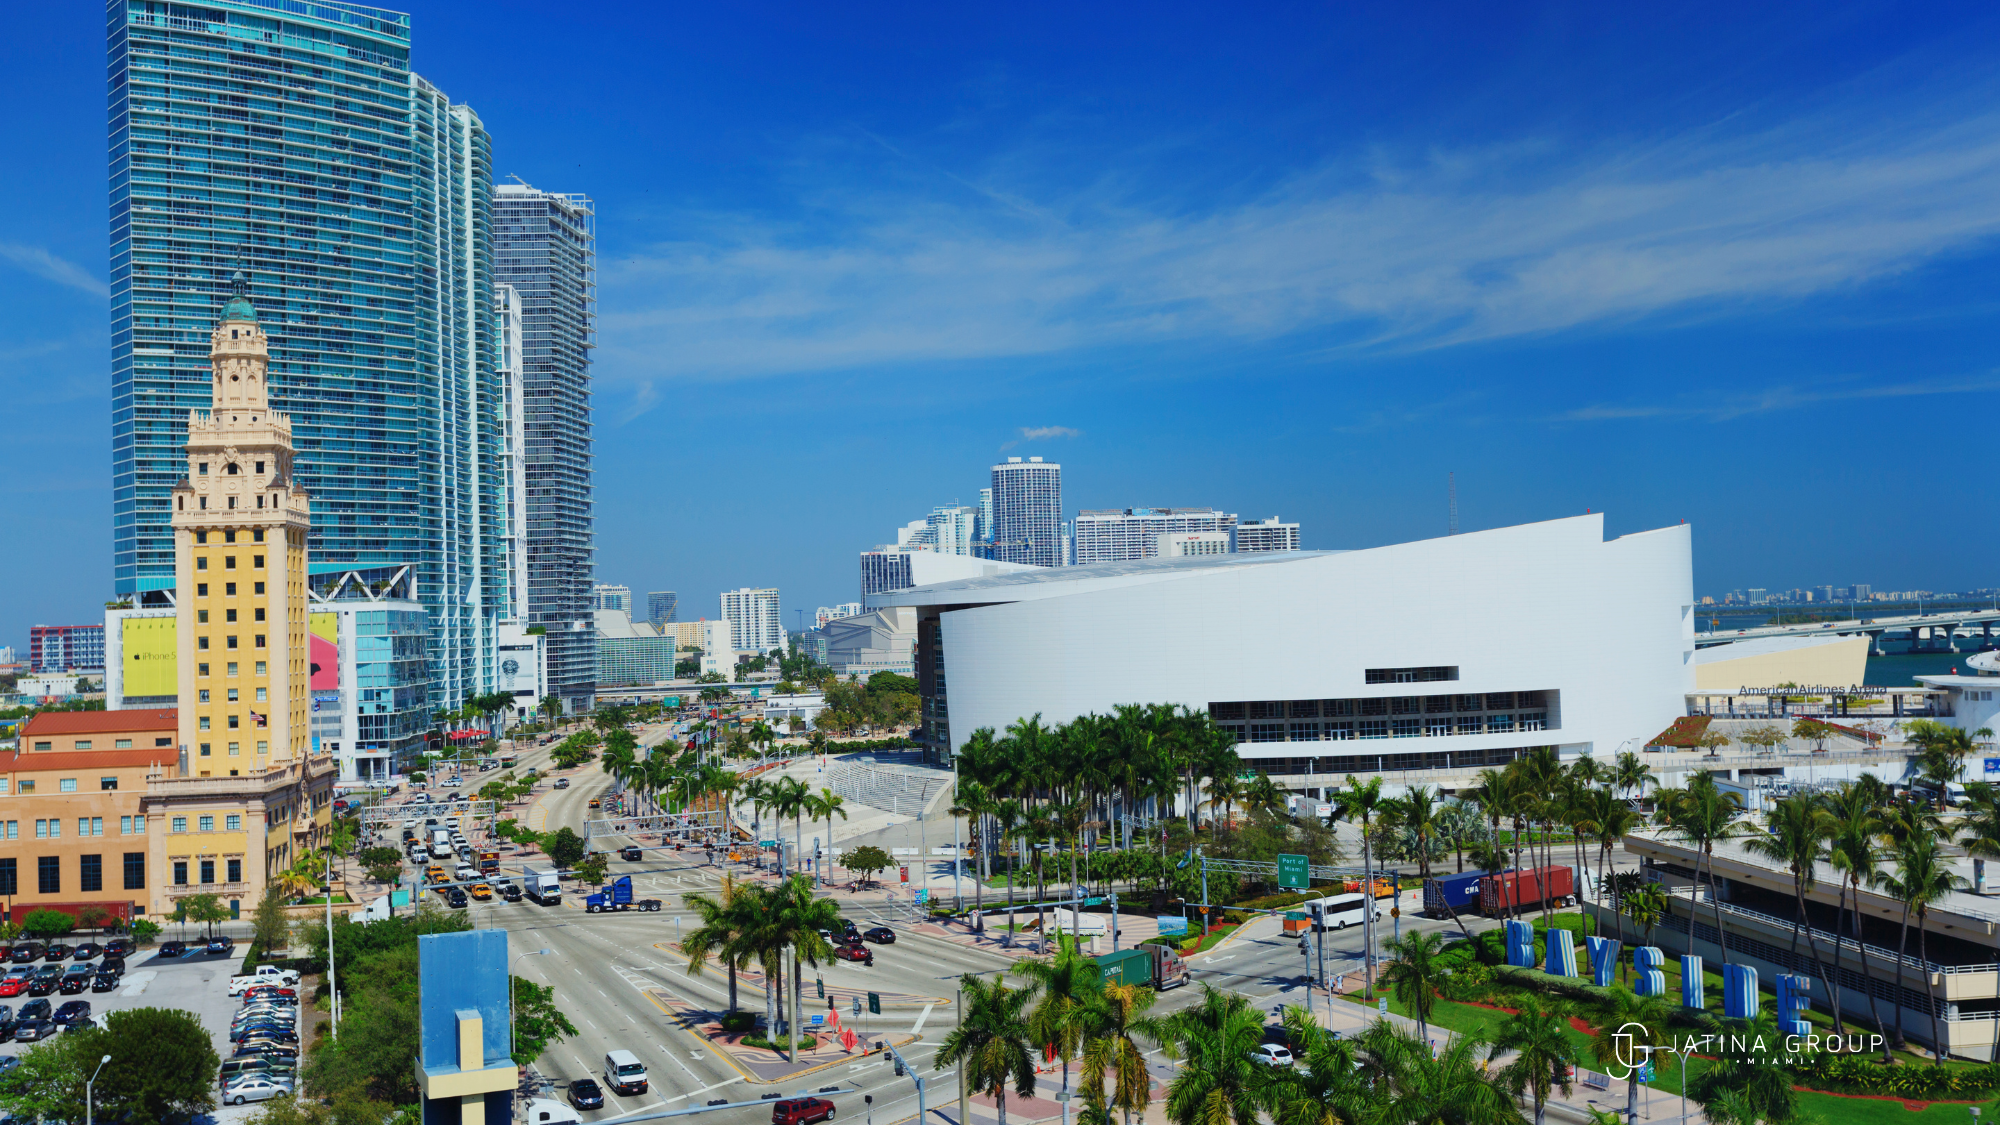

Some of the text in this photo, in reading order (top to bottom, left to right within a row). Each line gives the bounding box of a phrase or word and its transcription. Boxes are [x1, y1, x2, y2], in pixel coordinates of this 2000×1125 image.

[142, 651, 177, 661] iPhone 5
[1849, 684, 1888, 696] Arena
[1465, 886, 1479, 894] CMA
[1104, 966, 1122, 976] CAPITAL
[1507, 920, 1812, 1035] BAYSIDE
